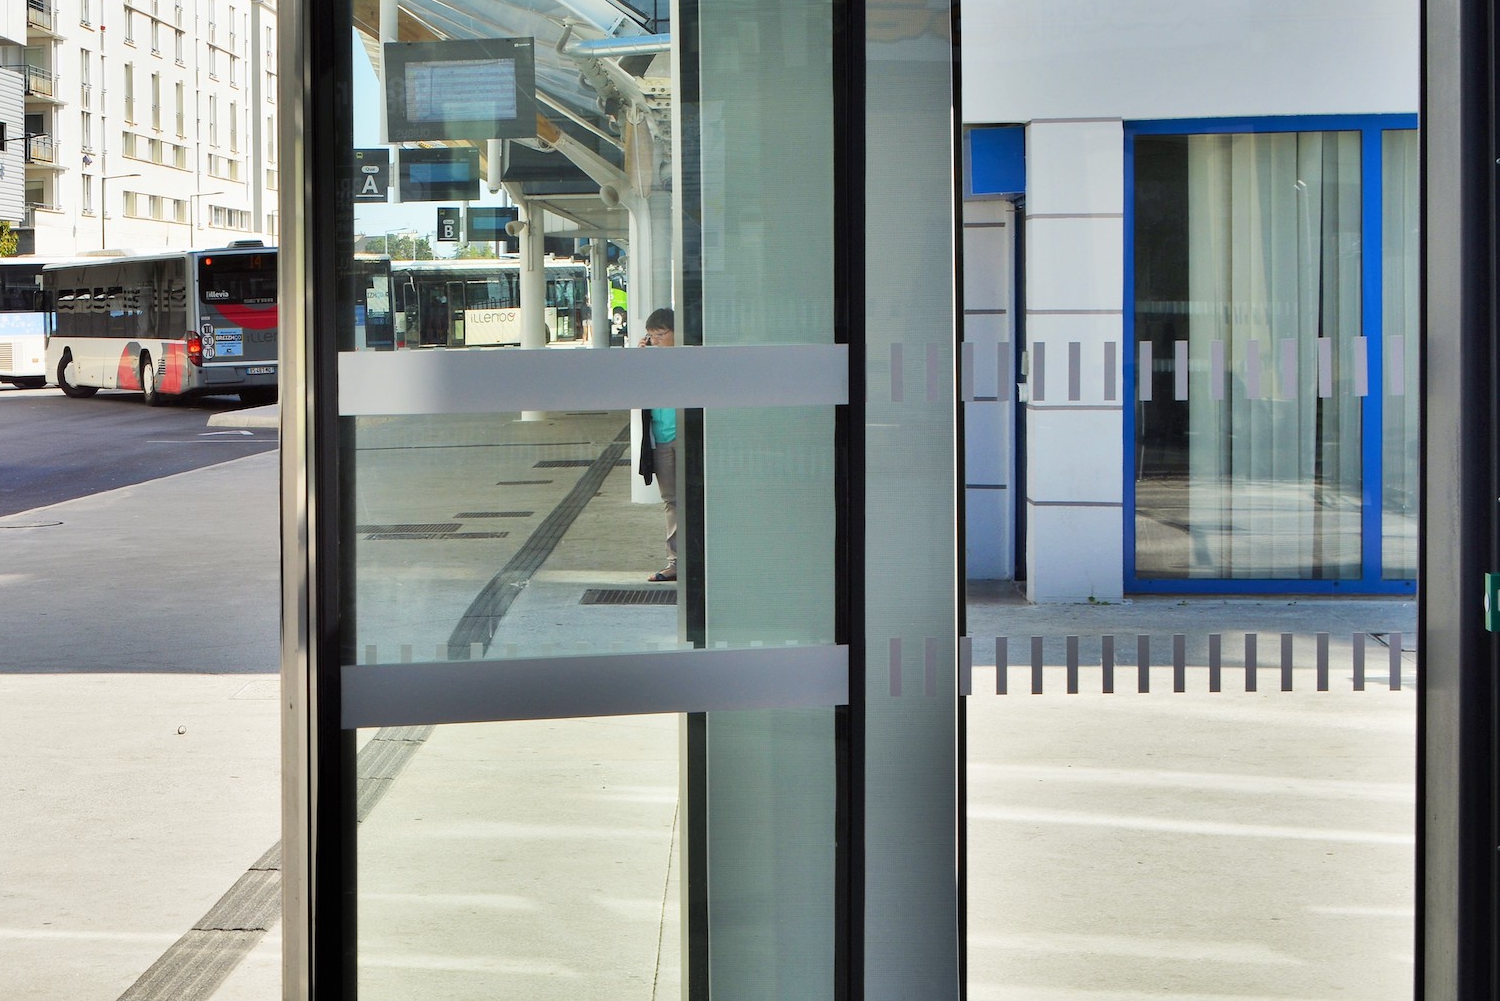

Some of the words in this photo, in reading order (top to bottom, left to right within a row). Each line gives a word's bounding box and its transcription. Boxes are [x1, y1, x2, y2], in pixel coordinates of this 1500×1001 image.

[362, 175, 379, 194] A
[444, 225, 454, 238] B
[203, 337, 213, 346] 90
[204, 349, 213, 358] 70
